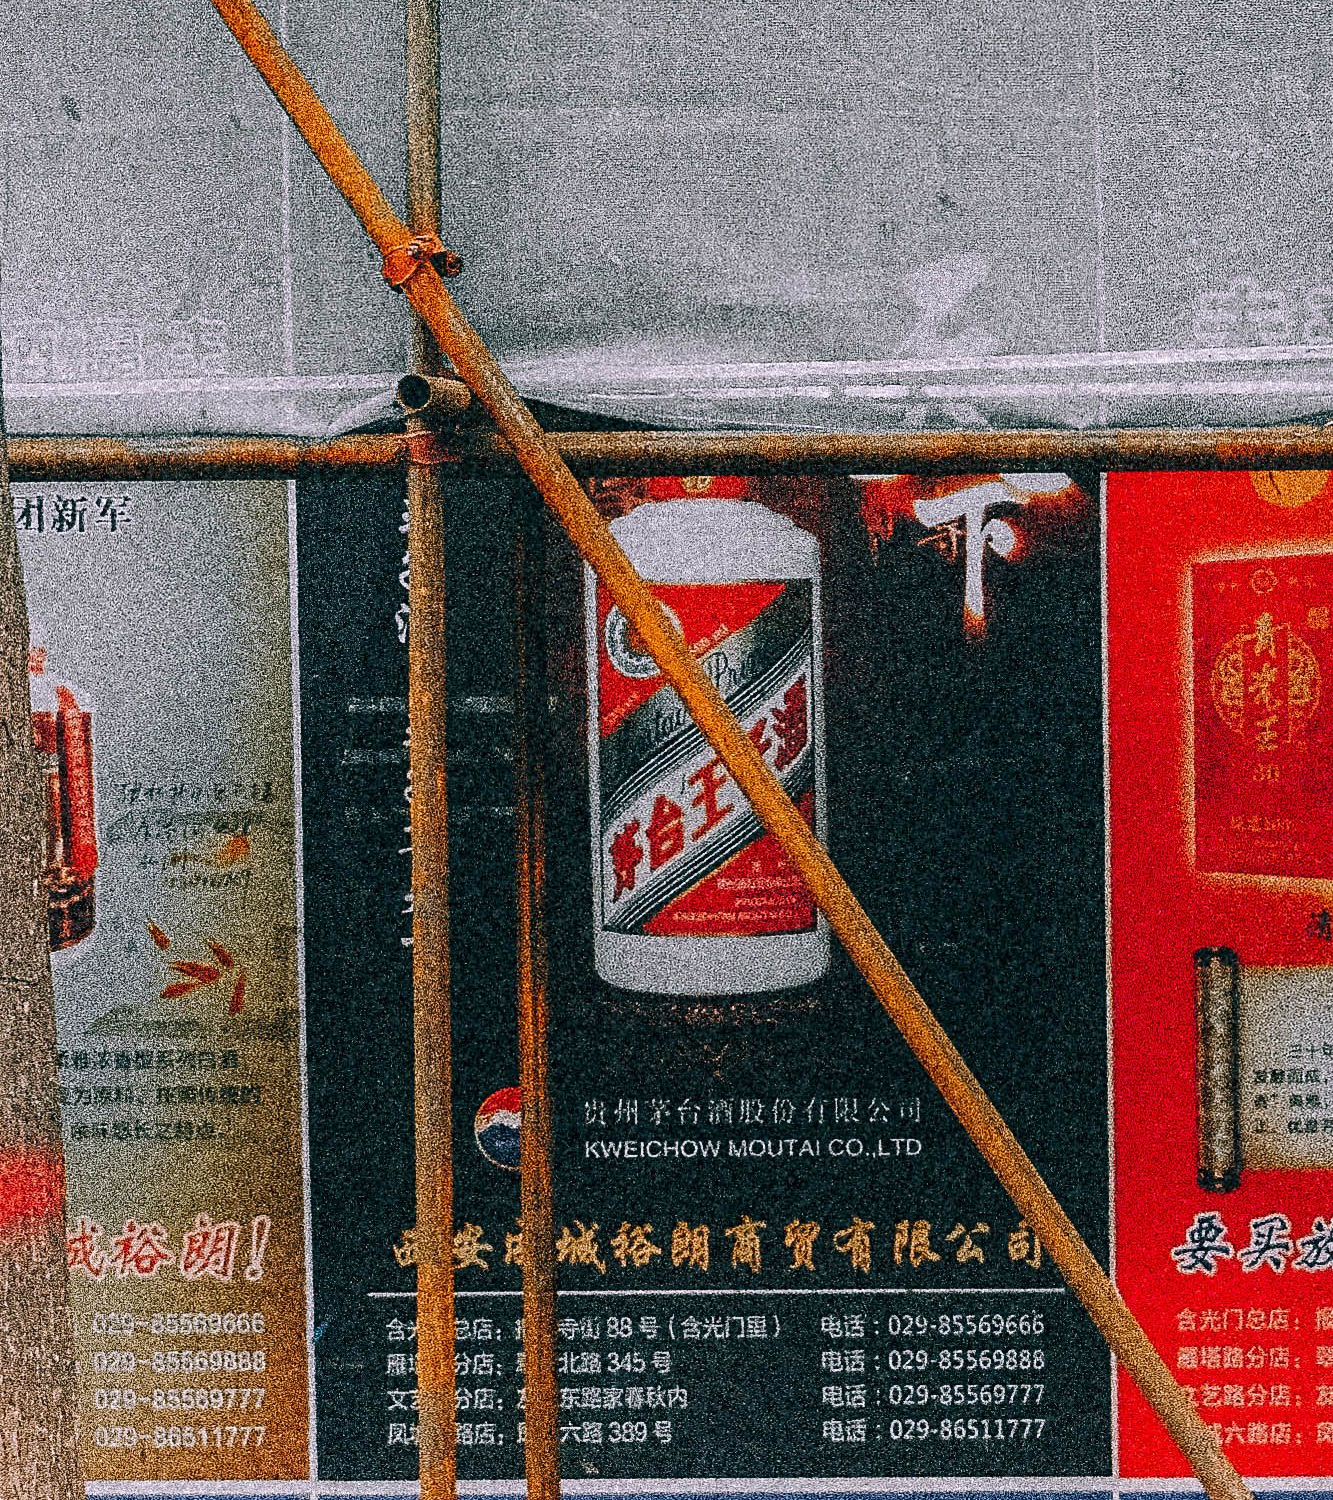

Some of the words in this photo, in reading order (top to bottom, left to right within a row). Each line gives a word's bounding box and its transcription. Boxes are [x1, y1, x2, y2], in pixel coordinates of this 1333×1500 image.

[584, 1139, 721, 1160] KWEICHOW
[728, 1138, 820, 1159] MOUTAI
[92, 1313, 265, 1336] 029-85569666
[93, 1351, 266, 1374] 029-85569888
[94, 1388, 266, 1411] 029-85569777
